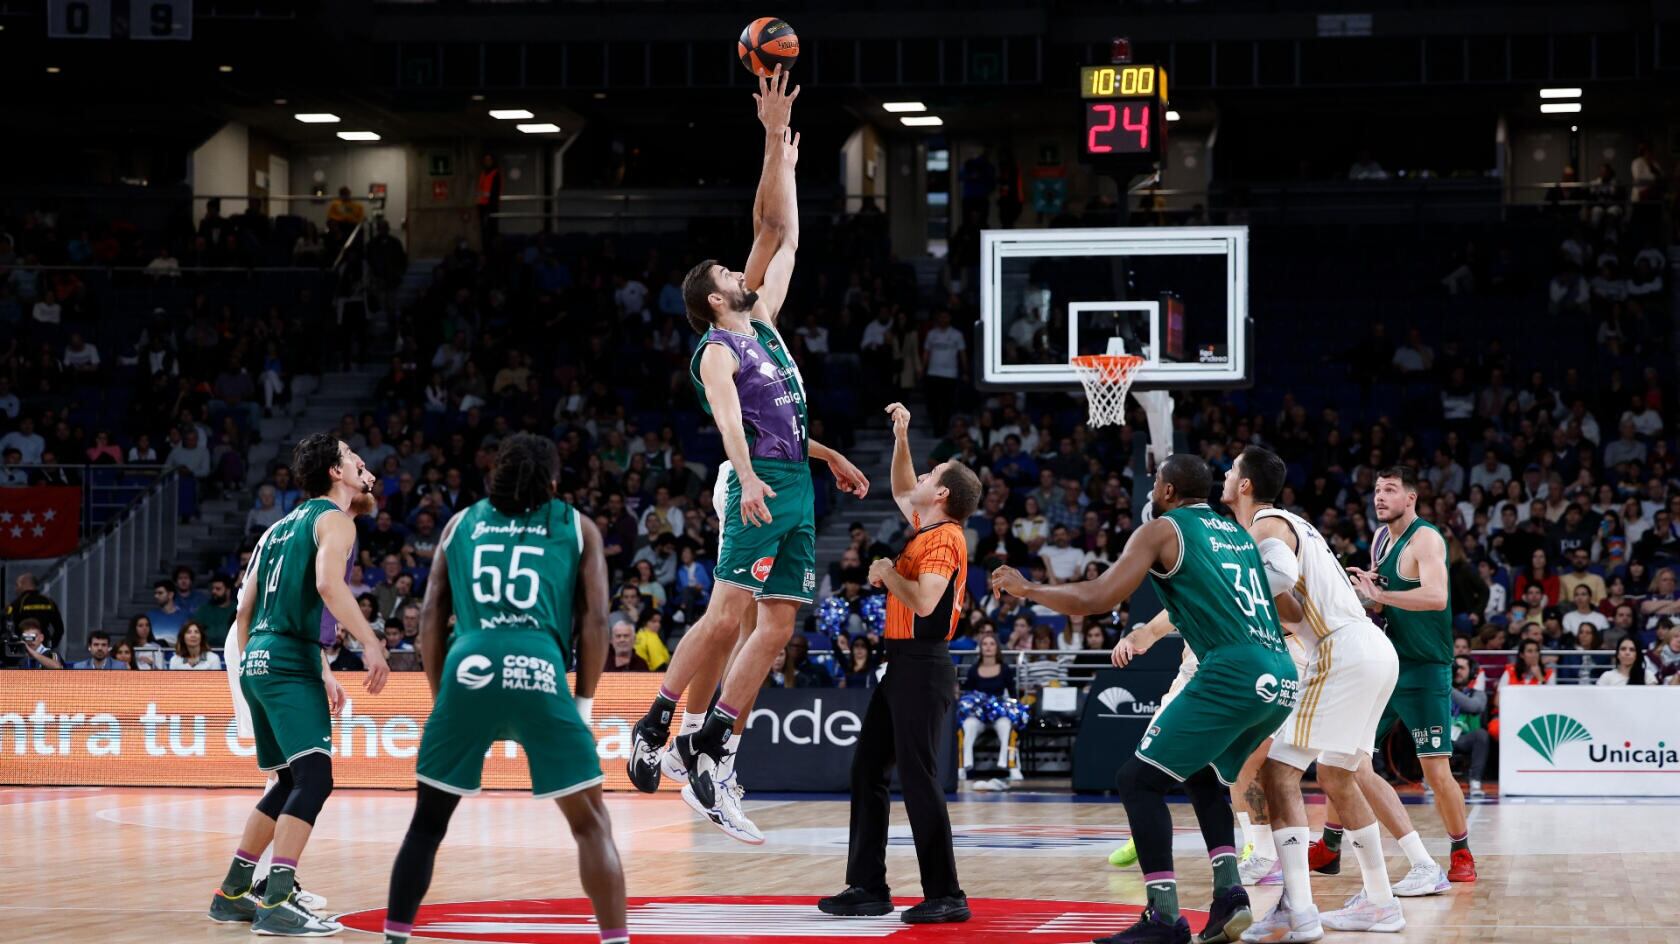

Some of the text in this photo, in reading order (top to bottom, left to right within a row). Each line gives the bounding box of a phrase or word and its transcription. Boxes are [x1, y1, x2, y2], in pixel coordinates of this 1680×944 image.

[1092, 67, 1155, 95] 10:00
[1087, 104, 1149, 152] 24
[472, 543, 545, 609] 55
[1221, 562, 1272, 620] 34
[502, 668, 531, 681] DEL
[503, 655, 556, 677] COSTA
[502, 678, 558, 695] MÁLAGA
[140, 702, 207, 757] tu
[1589, 741, 1679, 768] Unicaja
